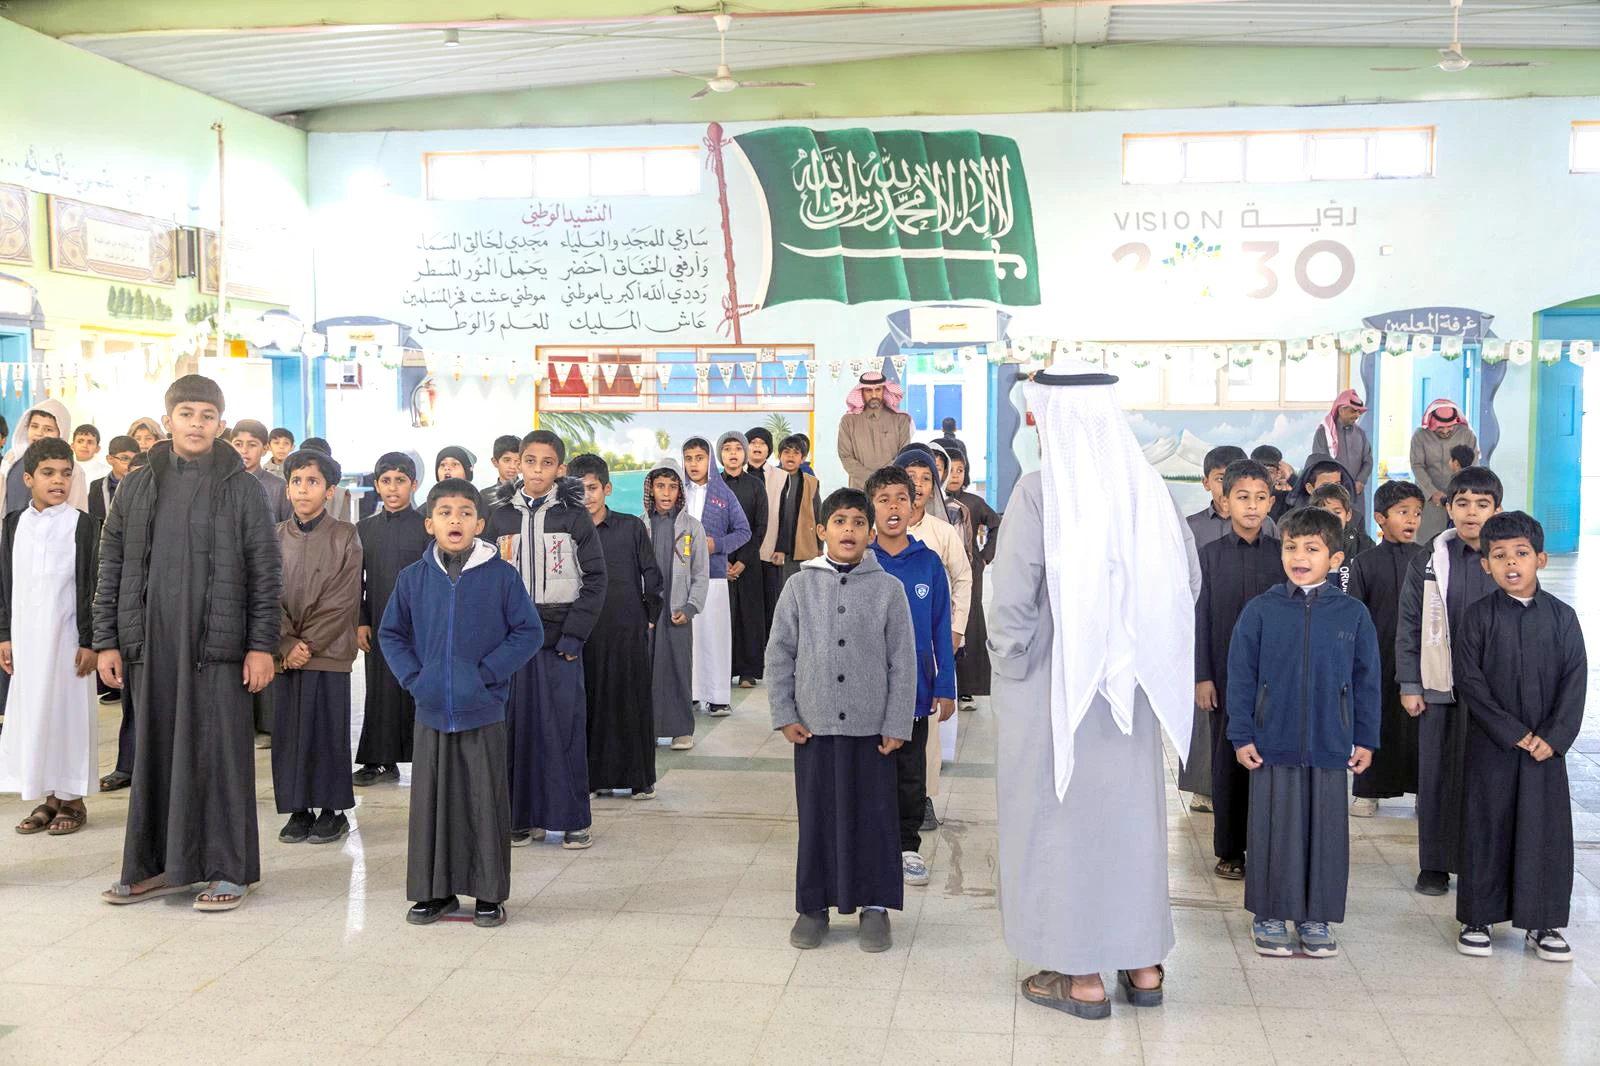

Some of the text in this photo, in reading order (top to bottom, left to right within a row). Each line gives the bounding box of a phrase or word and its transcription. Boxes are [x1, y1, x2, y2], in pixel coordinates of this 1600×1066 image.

[521, 200, 613, 228] النشيد الوطني
[1113, 209, 1223, 232] VISION
[504, 230, 549, 254] مجدي
[559, 228, 619, 253] والعلياء
[621, 224, 665, 250] للمجد
[667, 227, 709, 251] سارعي
[463, 255, 498, 282] النور
[500, 256, 548, 281] يحمل
[612, 253, 667, 277] الخفاق
[470, 287, 511, 304] عشت
[510, 285, 547, 308] موطني
[667, 283, 709, 305] رددي
[499, 311, 550, 340] للعلم
[568, 309, 642, 335] المليك
[644, 310, 707, 334] عاش
[1384, 312, 1478, 336] غرفة المعلمين
